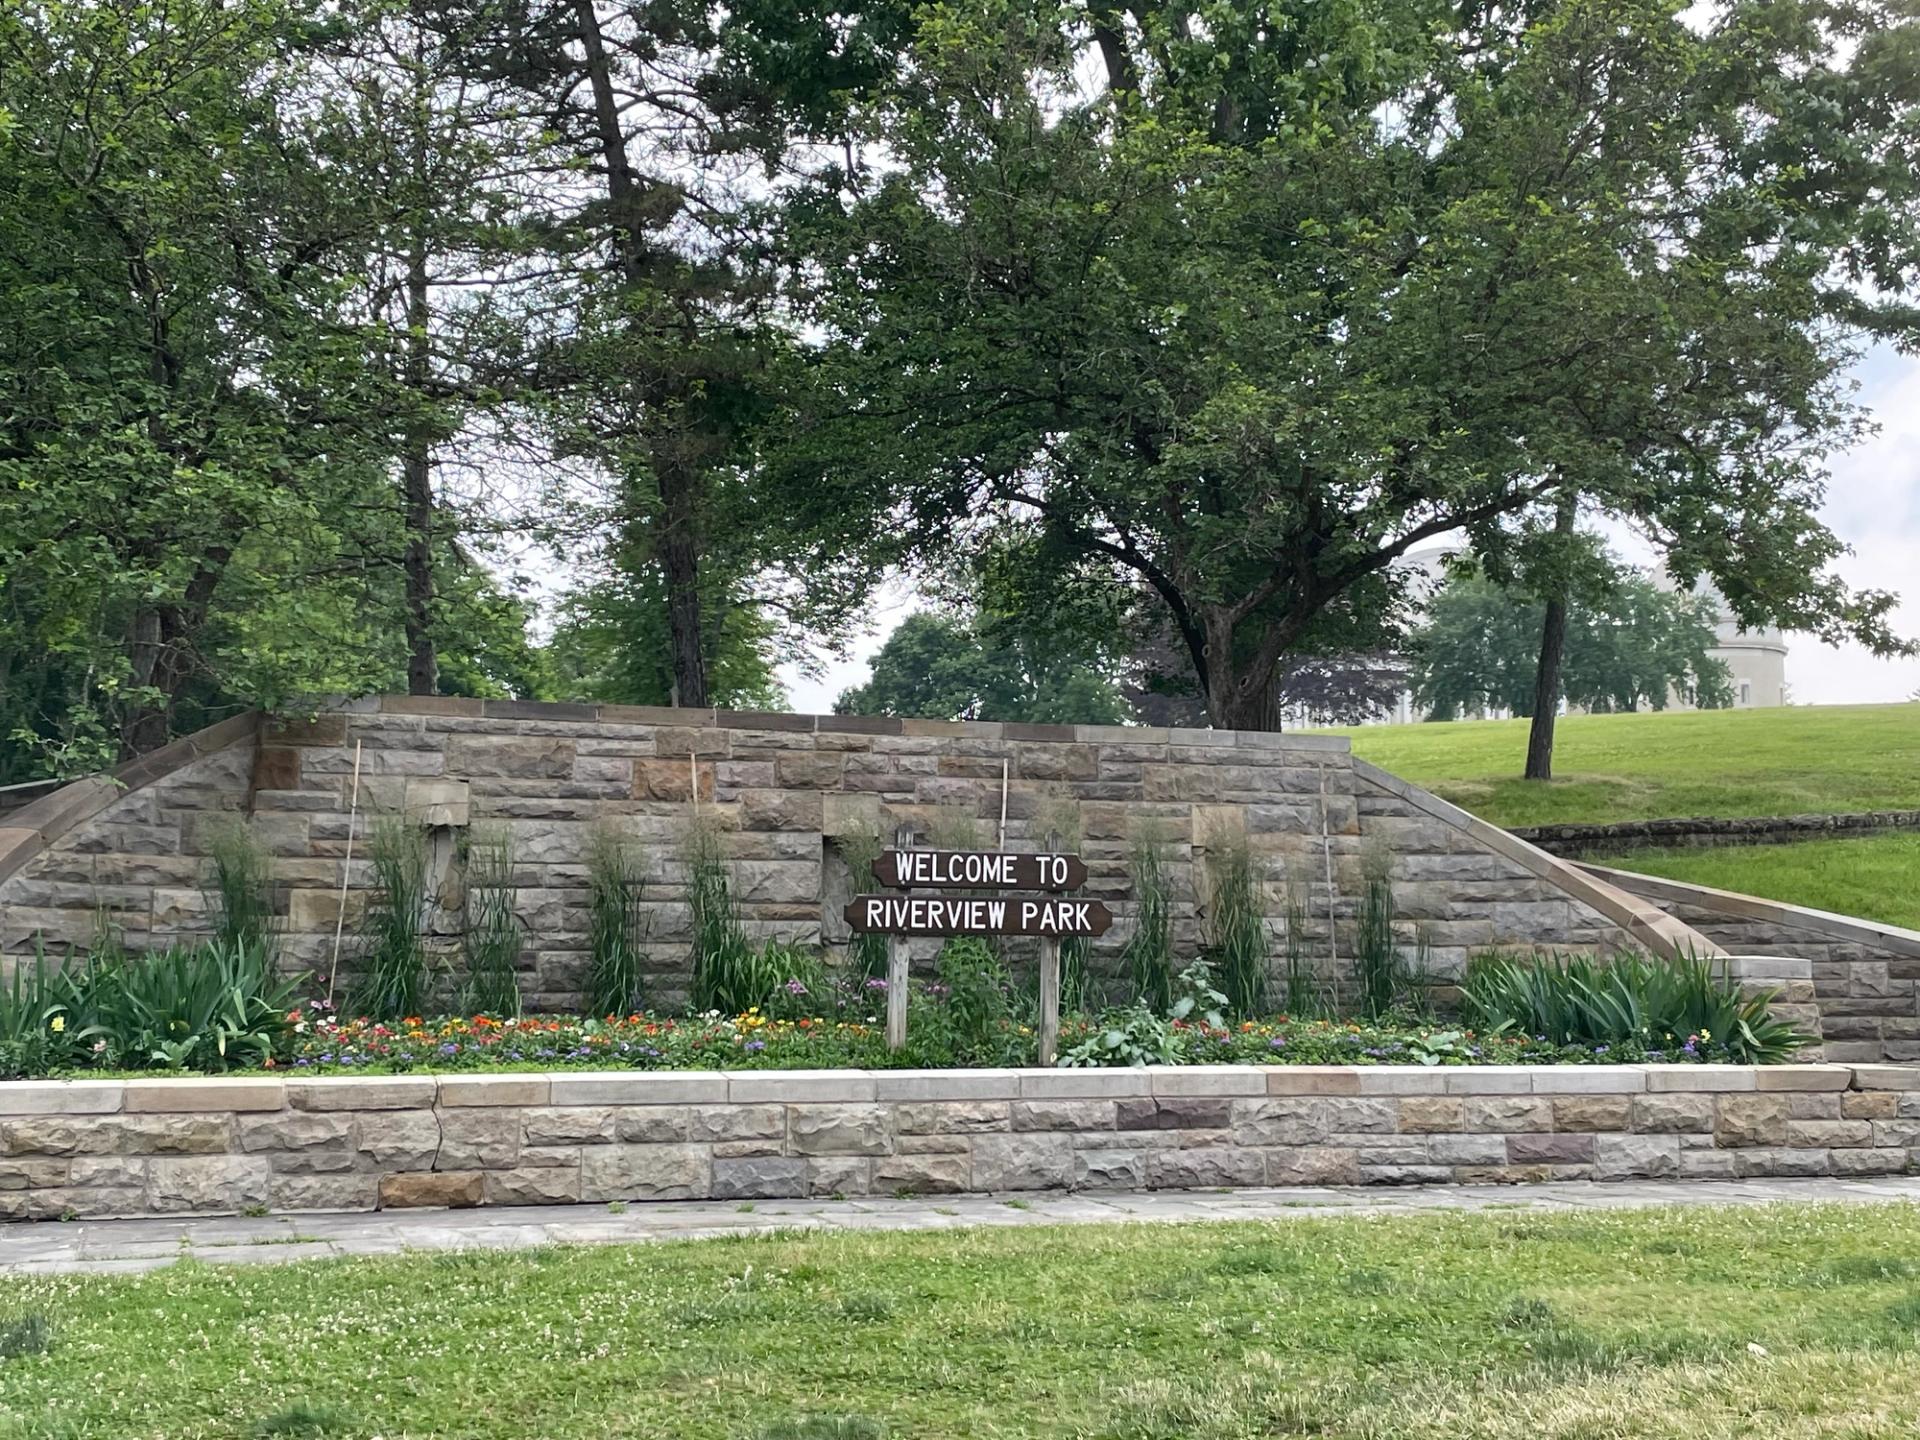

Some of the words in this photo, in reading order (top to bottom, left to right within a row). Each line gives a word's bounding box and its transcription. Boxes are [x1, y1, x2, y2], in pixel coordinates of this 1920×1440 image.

[896, 853, 1018, 883] WELCOME
[1036, 856, 1069, 884] TO
[866, 900, 1006, 930] RIVERVIEW
[1022, 902, 1092, 931] PARK
